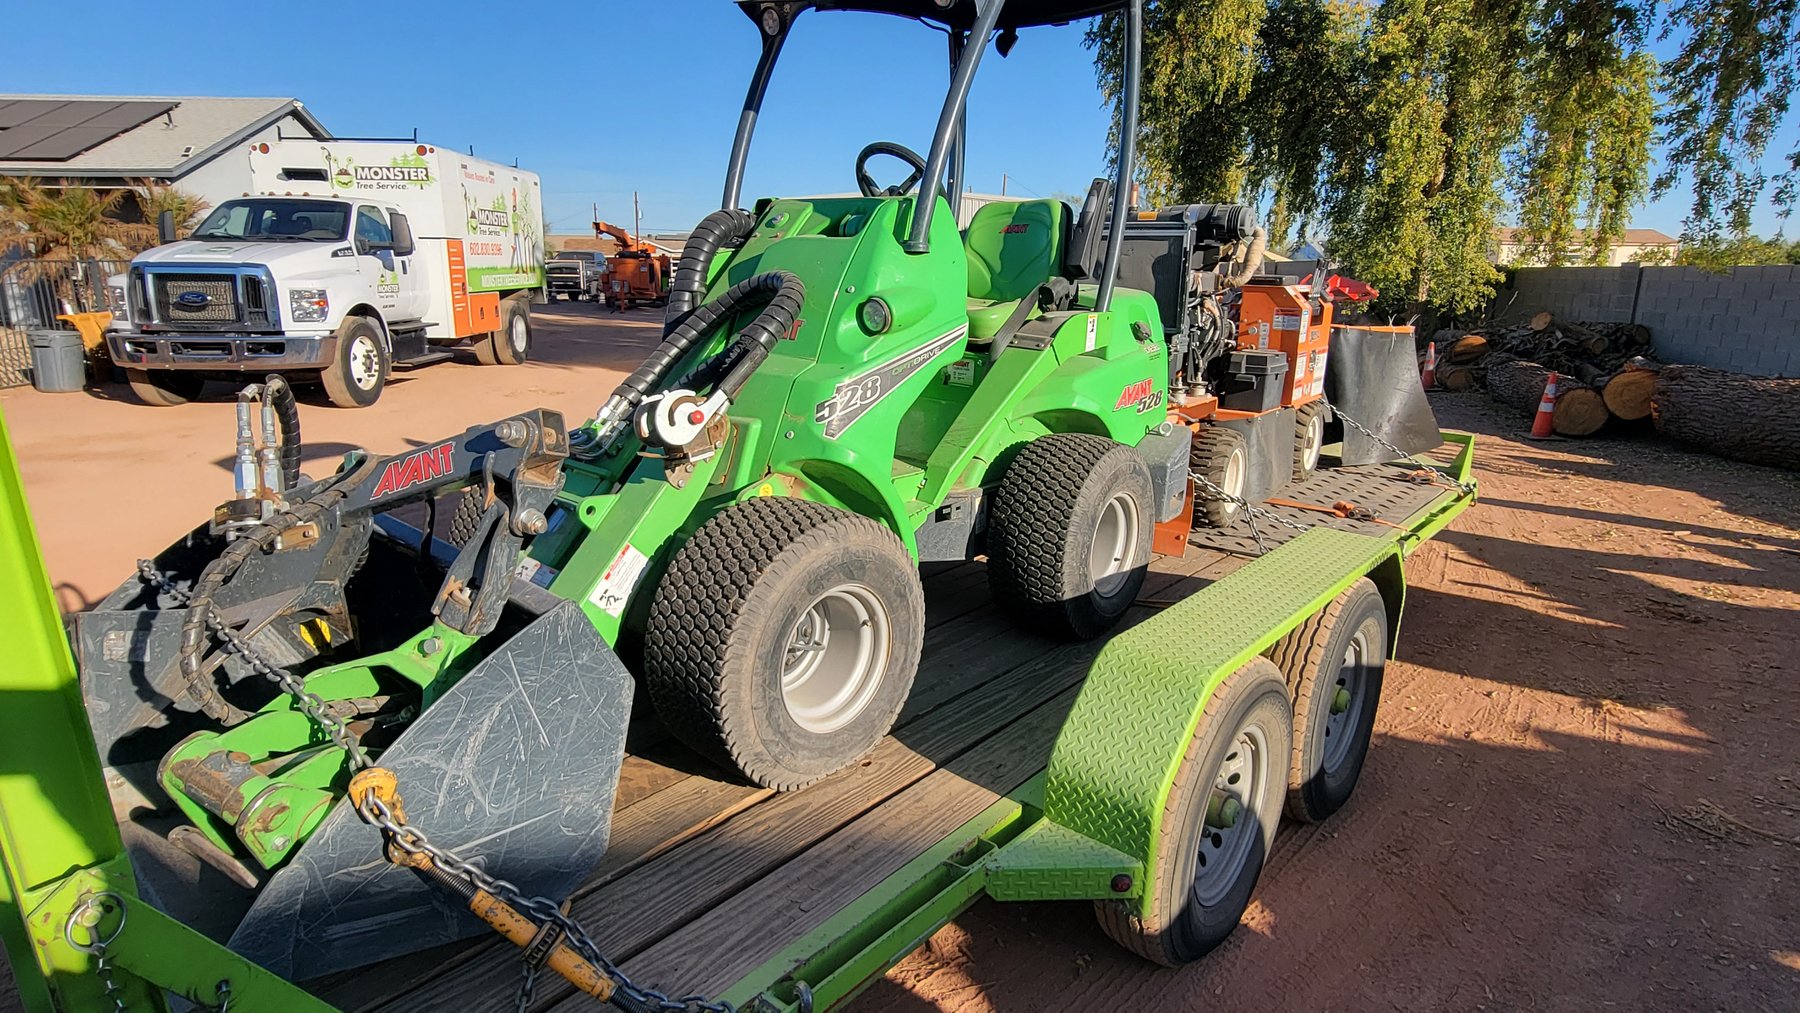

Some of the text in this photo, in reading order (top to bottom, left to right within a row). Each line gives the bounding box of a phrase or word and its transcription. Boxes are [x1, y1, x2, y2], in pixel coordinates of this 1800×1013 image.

[357, 167, 428, 181] MONSTER
[356, 181, 373, 190] Tree
[479, 209, 509, 227] MONSTER
[479, 226, 488, 236] Tree
[998, 223, 1030, 234] AVANT
[815, 375, 881, 423] 528
[1112, 377, 1153, 412] AVANT
[1136, 388, 1164, 415] 528
[370, 441, 456, 500] AVANT
